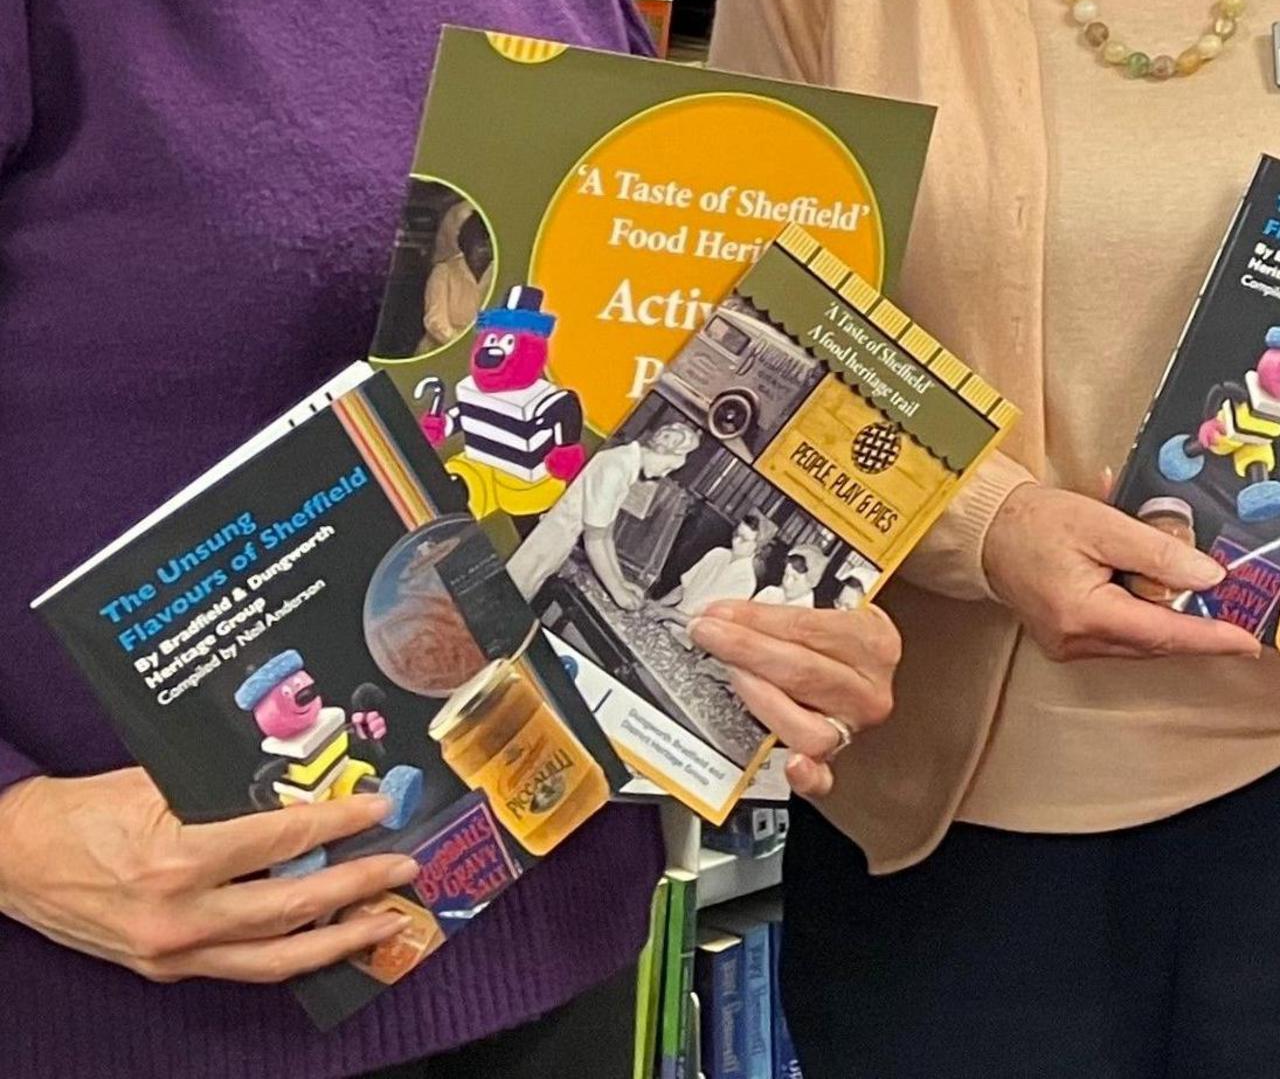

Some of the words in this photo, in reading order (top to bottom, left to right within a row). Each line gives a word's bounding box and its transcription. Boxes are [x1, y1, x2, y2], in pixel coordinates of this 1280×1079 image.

[607, 217, 688, 254] Food
[615, 170, 693, 208] Taste
[700, 185, 737, 214] of
[1253, 242, 1275, 260] By
[807, 323, 824, 340] A
[817, 331, 849, 365] food
[844, 352, 893, 399] heritage
[889, 386, 921, 418] trail
[836, 312, 867, 346] Taste
[863, 333, 884, 356] of
[831, 470, 866, 507] PLAY
[866, 498, 899, 534] PIES
[99, 583, 157, 624] The
[156, 511, 257, 585] Unsung
[117, 568, 228, 652] Flavours
[230, 541, 258, 571] of
[259, 465, 369, 549] Sheffield
[133, 651, 159, 673] By
[158, 595, 233, 656] Bradfield
[231, 586, 248, 602] &
[246, 523, 336, 592] Dungworth
[143, 633, 217, 690] Heritage
[215, 596, 266, 636] Group
[156, 655, 221, 705] Compiled
[218, 643, 238, 660] by
[236, 620, 266, 647] Neil
[264, 578, 327, 627] Anderson
